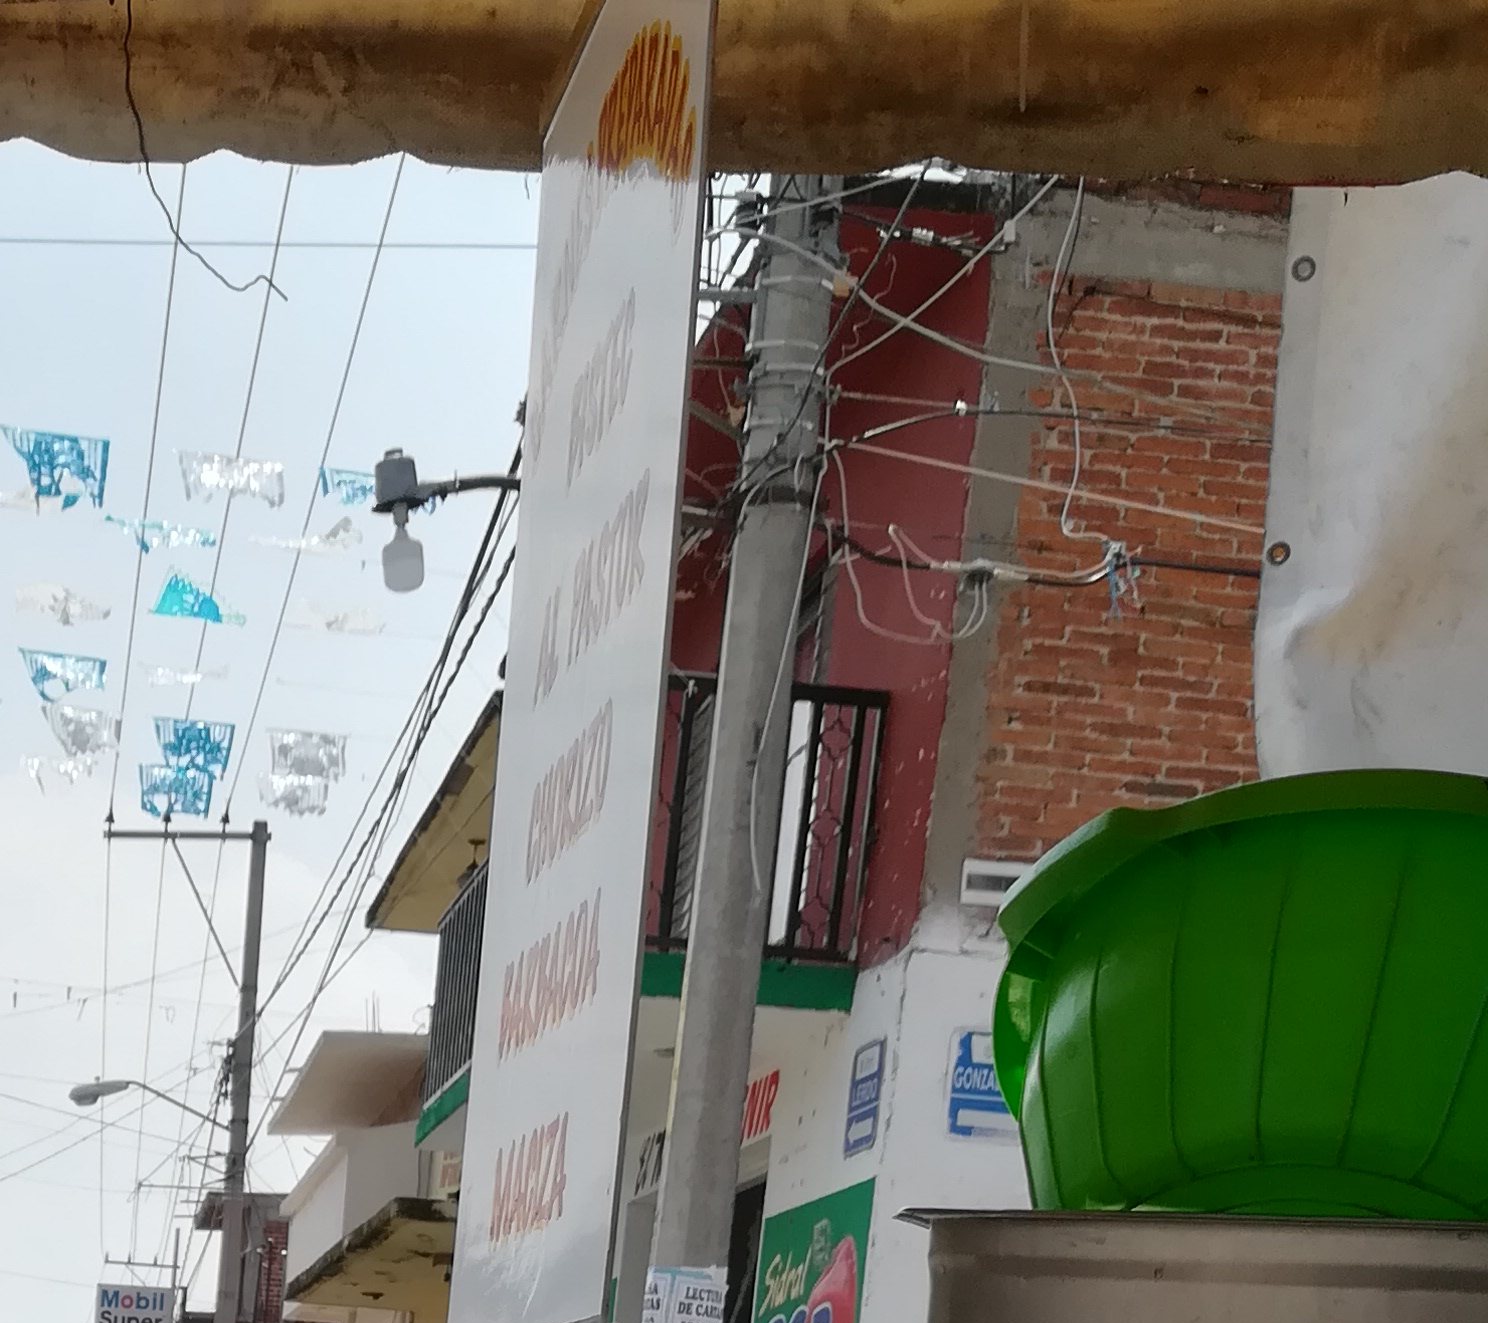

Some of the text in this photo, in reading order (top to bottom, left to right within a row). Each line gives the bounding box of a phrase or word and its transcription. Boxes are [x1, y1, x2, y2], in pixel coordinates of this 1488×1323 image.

[567, 285, 636, 488] BISTEC
[534, 467, 650, 712] AL PASTOR
[526, 696, 613, 890] CHORIZO
[498, 885, 602, 1067] BARBACOA
[740, 1068, 780, 1146] NIR
[100, 1289, 165, 1311] Mobil
[677, 1302, 693, 1316] DE
[758, 1246, 812, 1318] Sidral
